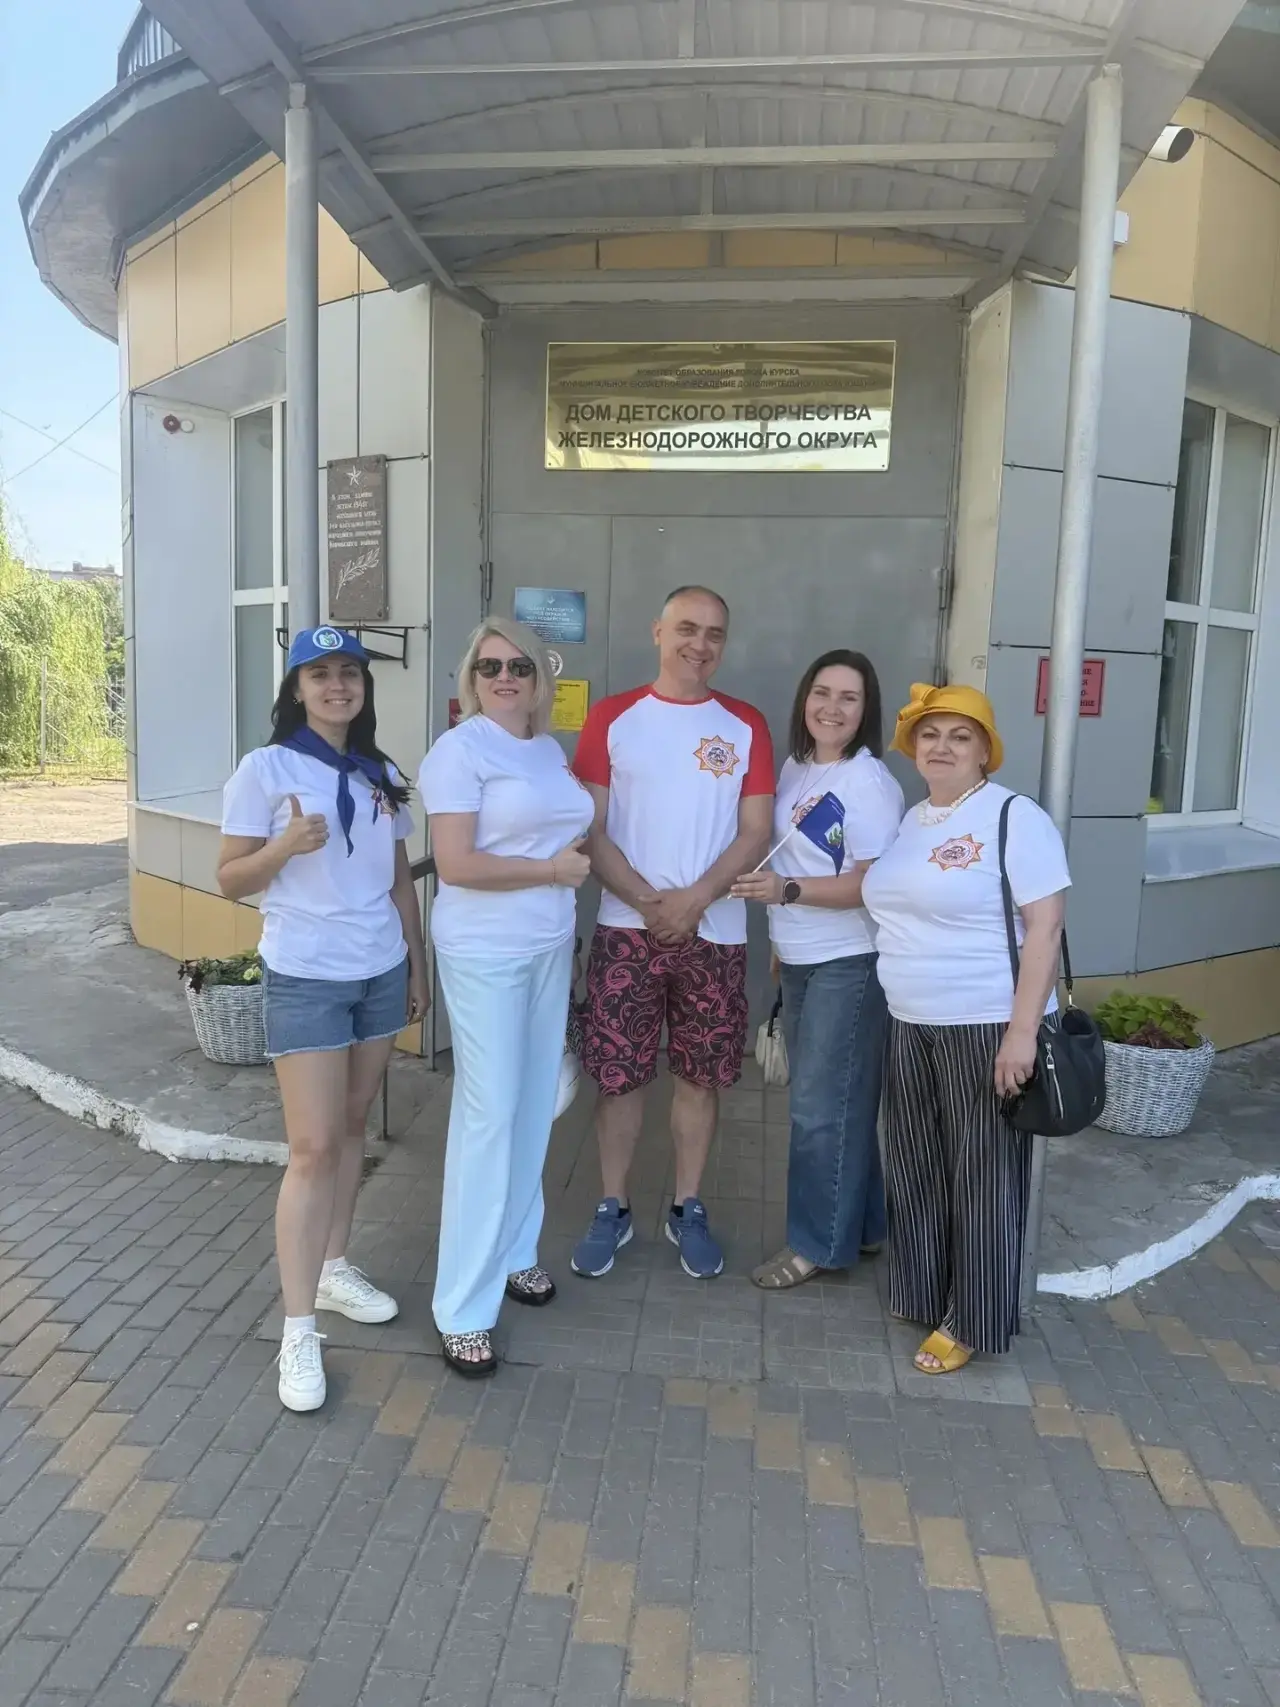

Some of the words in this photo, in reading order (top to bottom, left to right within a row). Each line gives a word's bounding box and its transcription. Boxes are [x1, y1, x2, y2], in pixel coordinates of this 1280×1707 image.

[769, 368, 800, 377] КУРСКА
[565, 404, 611, 423] ДОМ
[616, 404, 726, 423] ДЕТСКОГО
[731, 404, 872, 421] ТВОРЧЕСТВА
[558, 431, 792, 452] ЖЕЛЕЗНОДОРОЖНОГО
[797, 431, 878, 449] ОКРУГА
